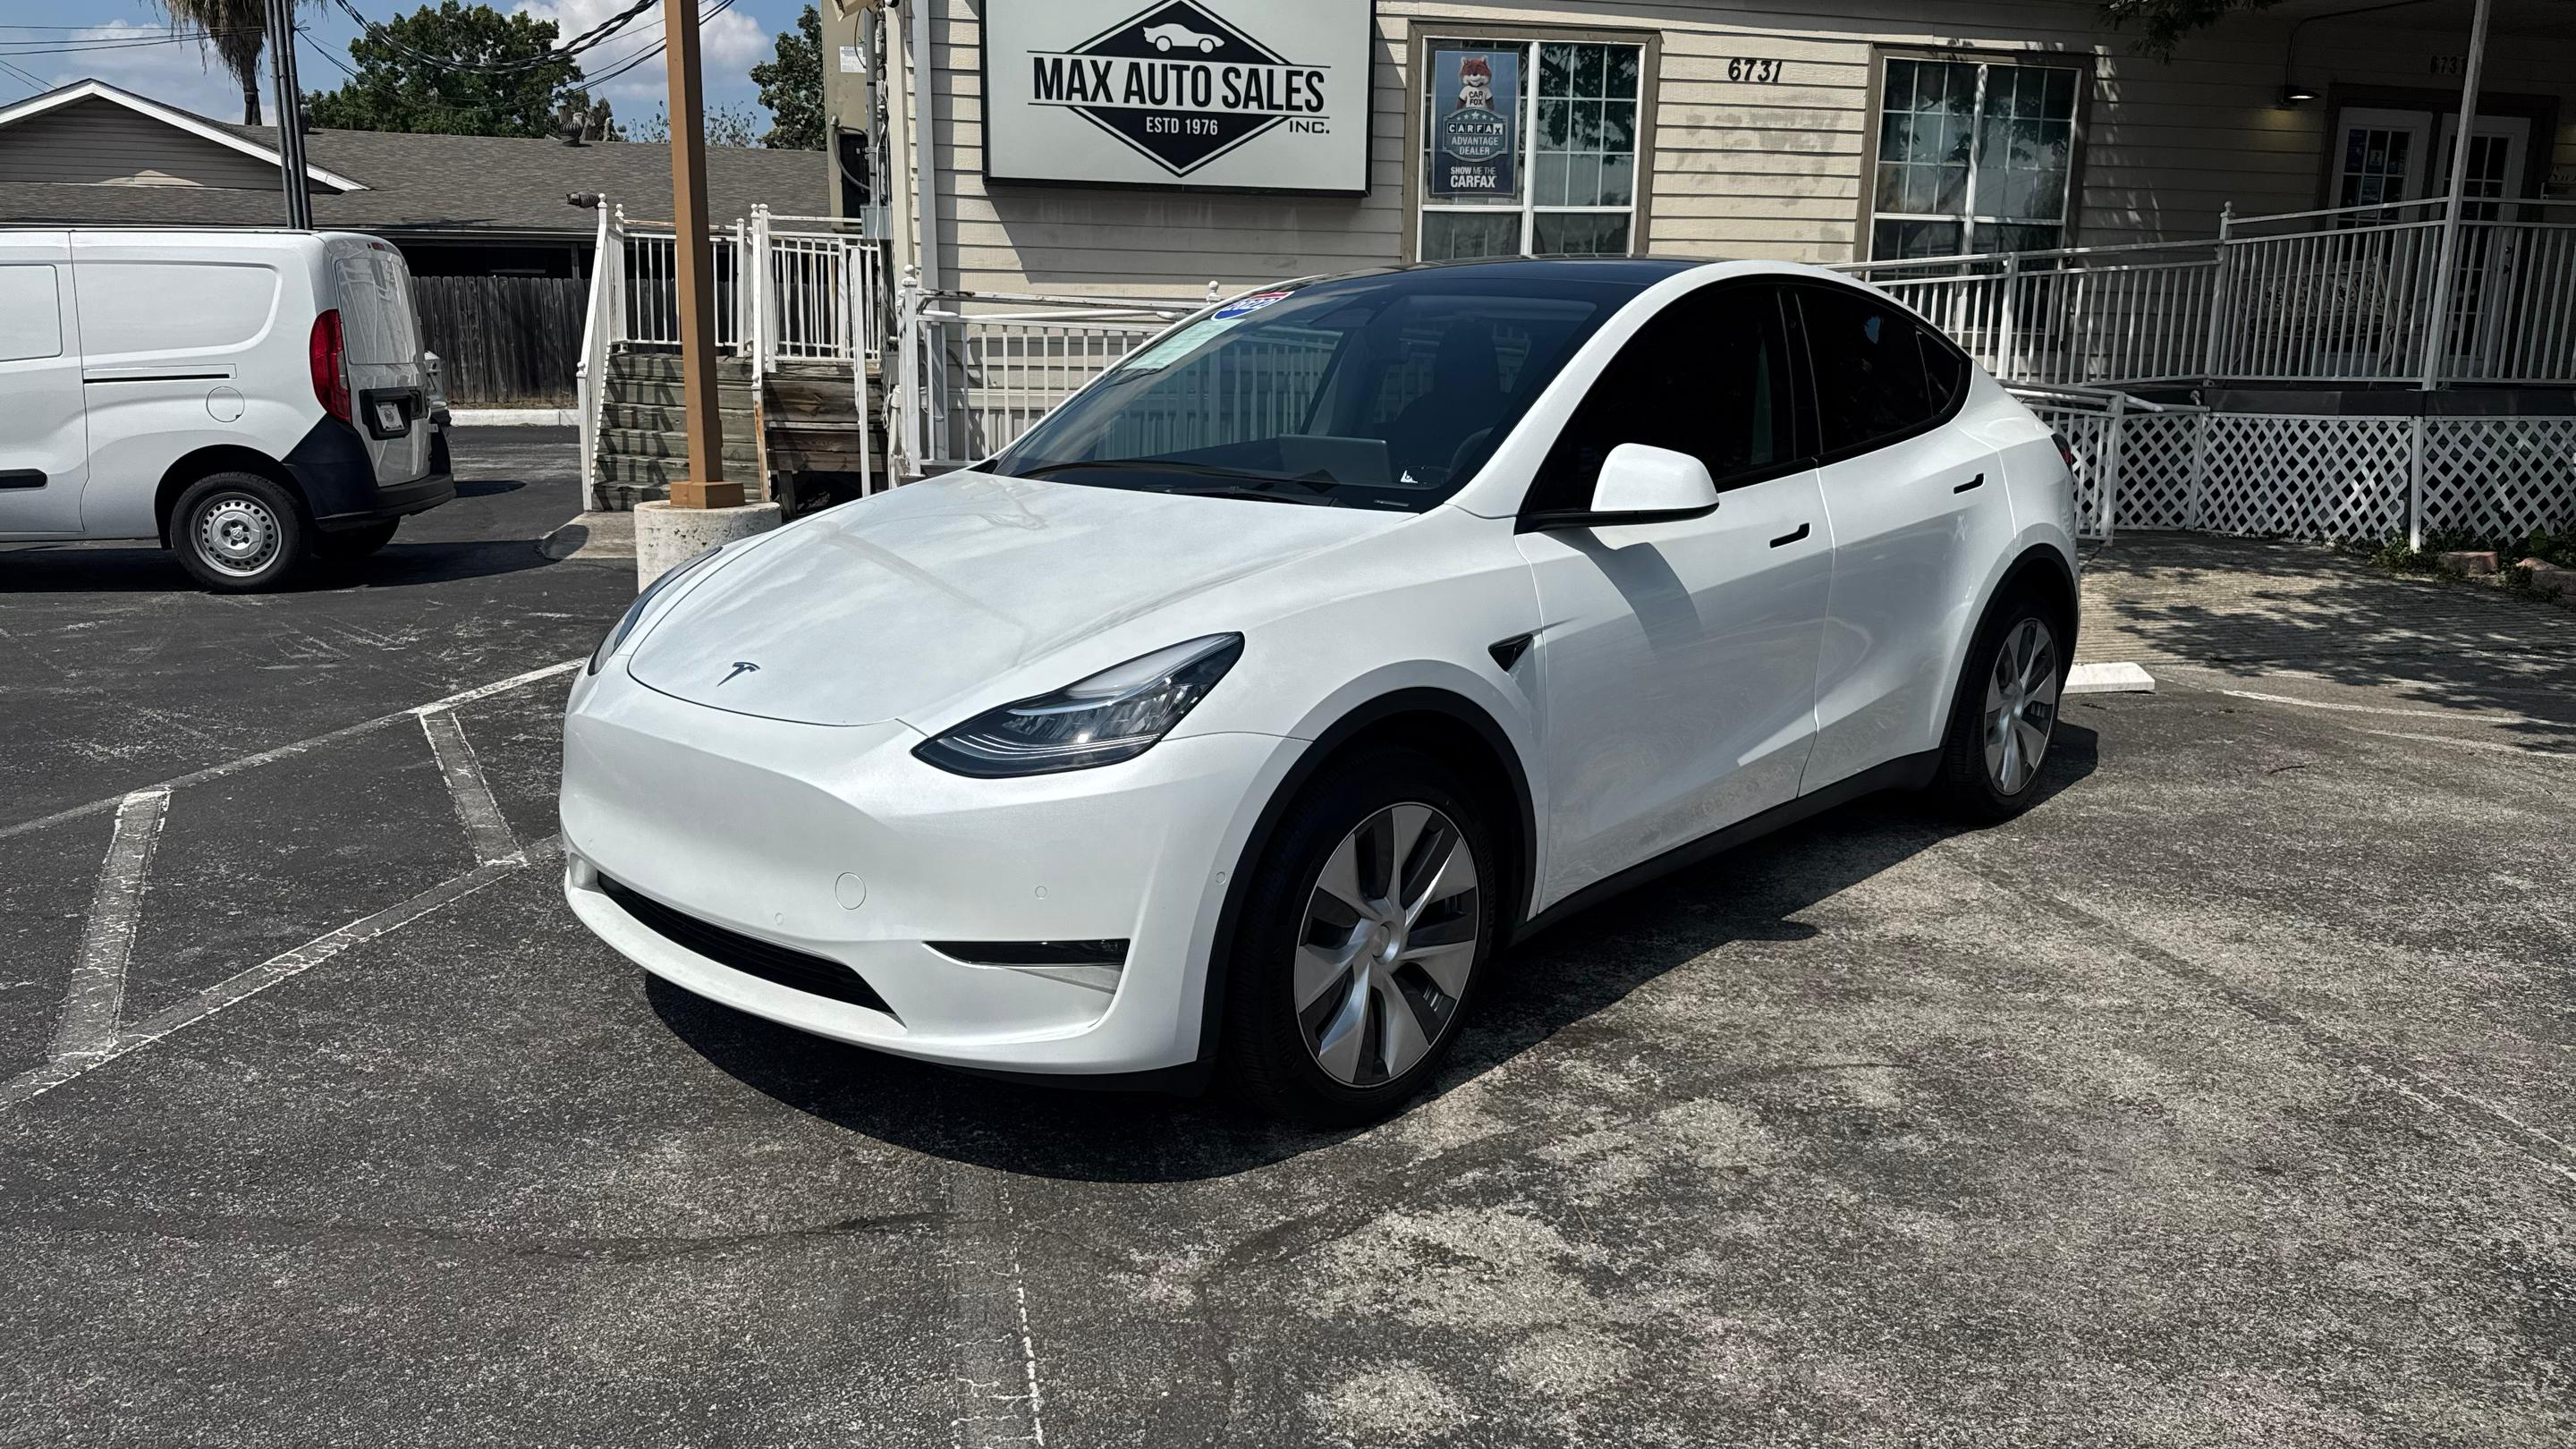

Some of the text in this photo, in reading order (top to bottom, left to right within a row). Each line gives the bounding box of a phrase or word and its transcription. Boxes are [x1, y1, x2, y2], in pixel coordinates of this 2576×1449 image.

[1728, 57, 1783, 82] 6731
[1033, 57, 1325, 113] MAX AUTO SALES
[1469, 90, 1483, 98] CAR
[1146, 116, 1218, 135] ESTD 1976
[1289, 121, 1330, 134] INC.
[1449, 124, 1501, 134] CARFAX
[1452, 136, 1498, 146] ADVANTAGE
[1459, 146, 1490, 156] DEALER
[1450, 166, 1496, 175] SHOW ME THE
[1450, 174, 1496, 188] CARFAX
